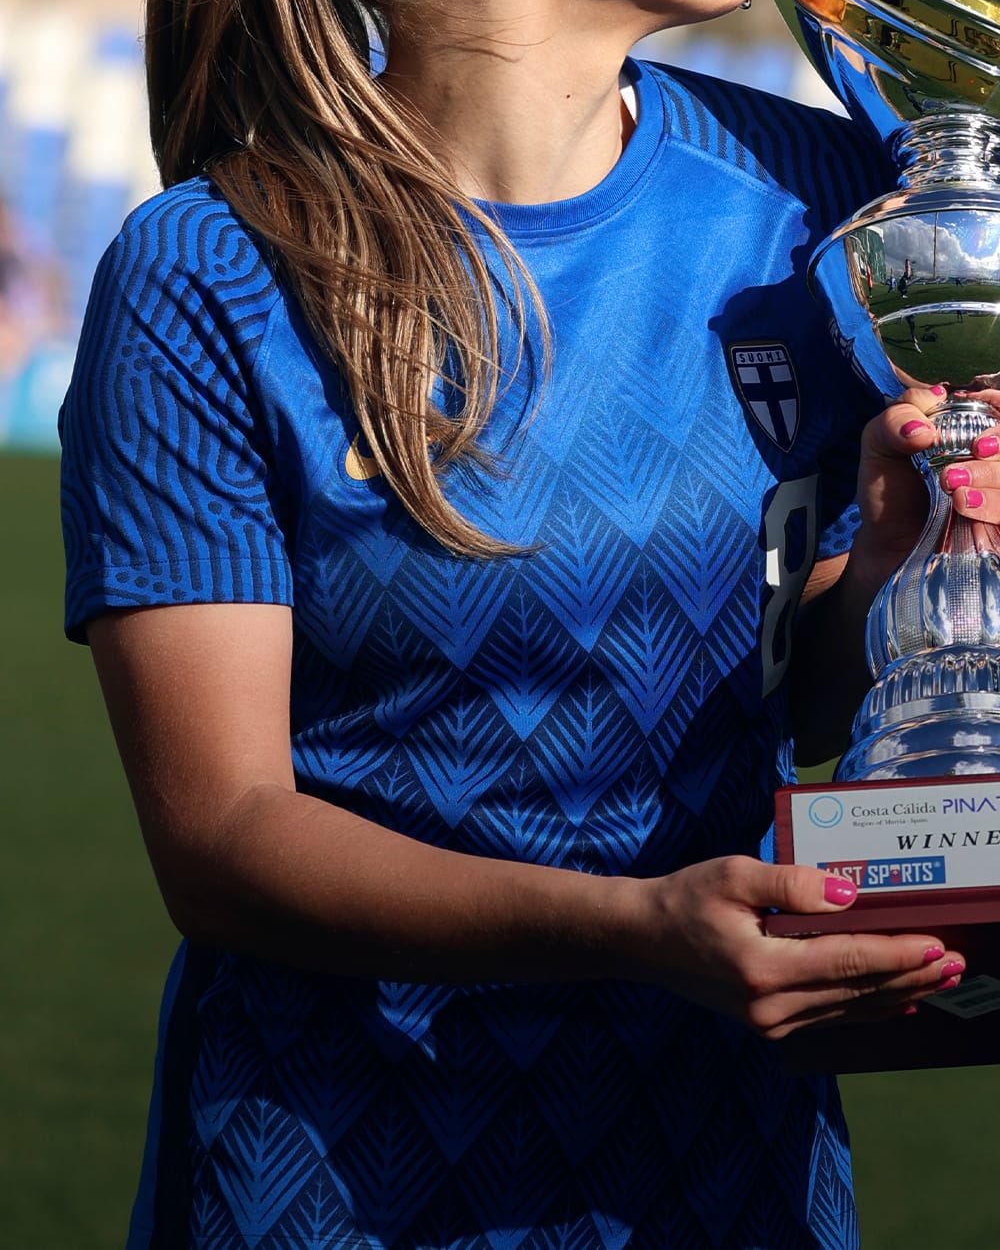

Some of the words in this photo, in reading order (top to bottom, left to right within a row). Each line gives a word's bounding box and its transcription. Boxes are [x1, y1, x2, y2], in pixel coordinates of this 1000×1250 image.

[738, 351, 782, 363] SUOMI
[851, 806, 889, 818] Costa
[892, 802, 937, 816] Cálida
[867, 862, 934, 885] SPORTS
